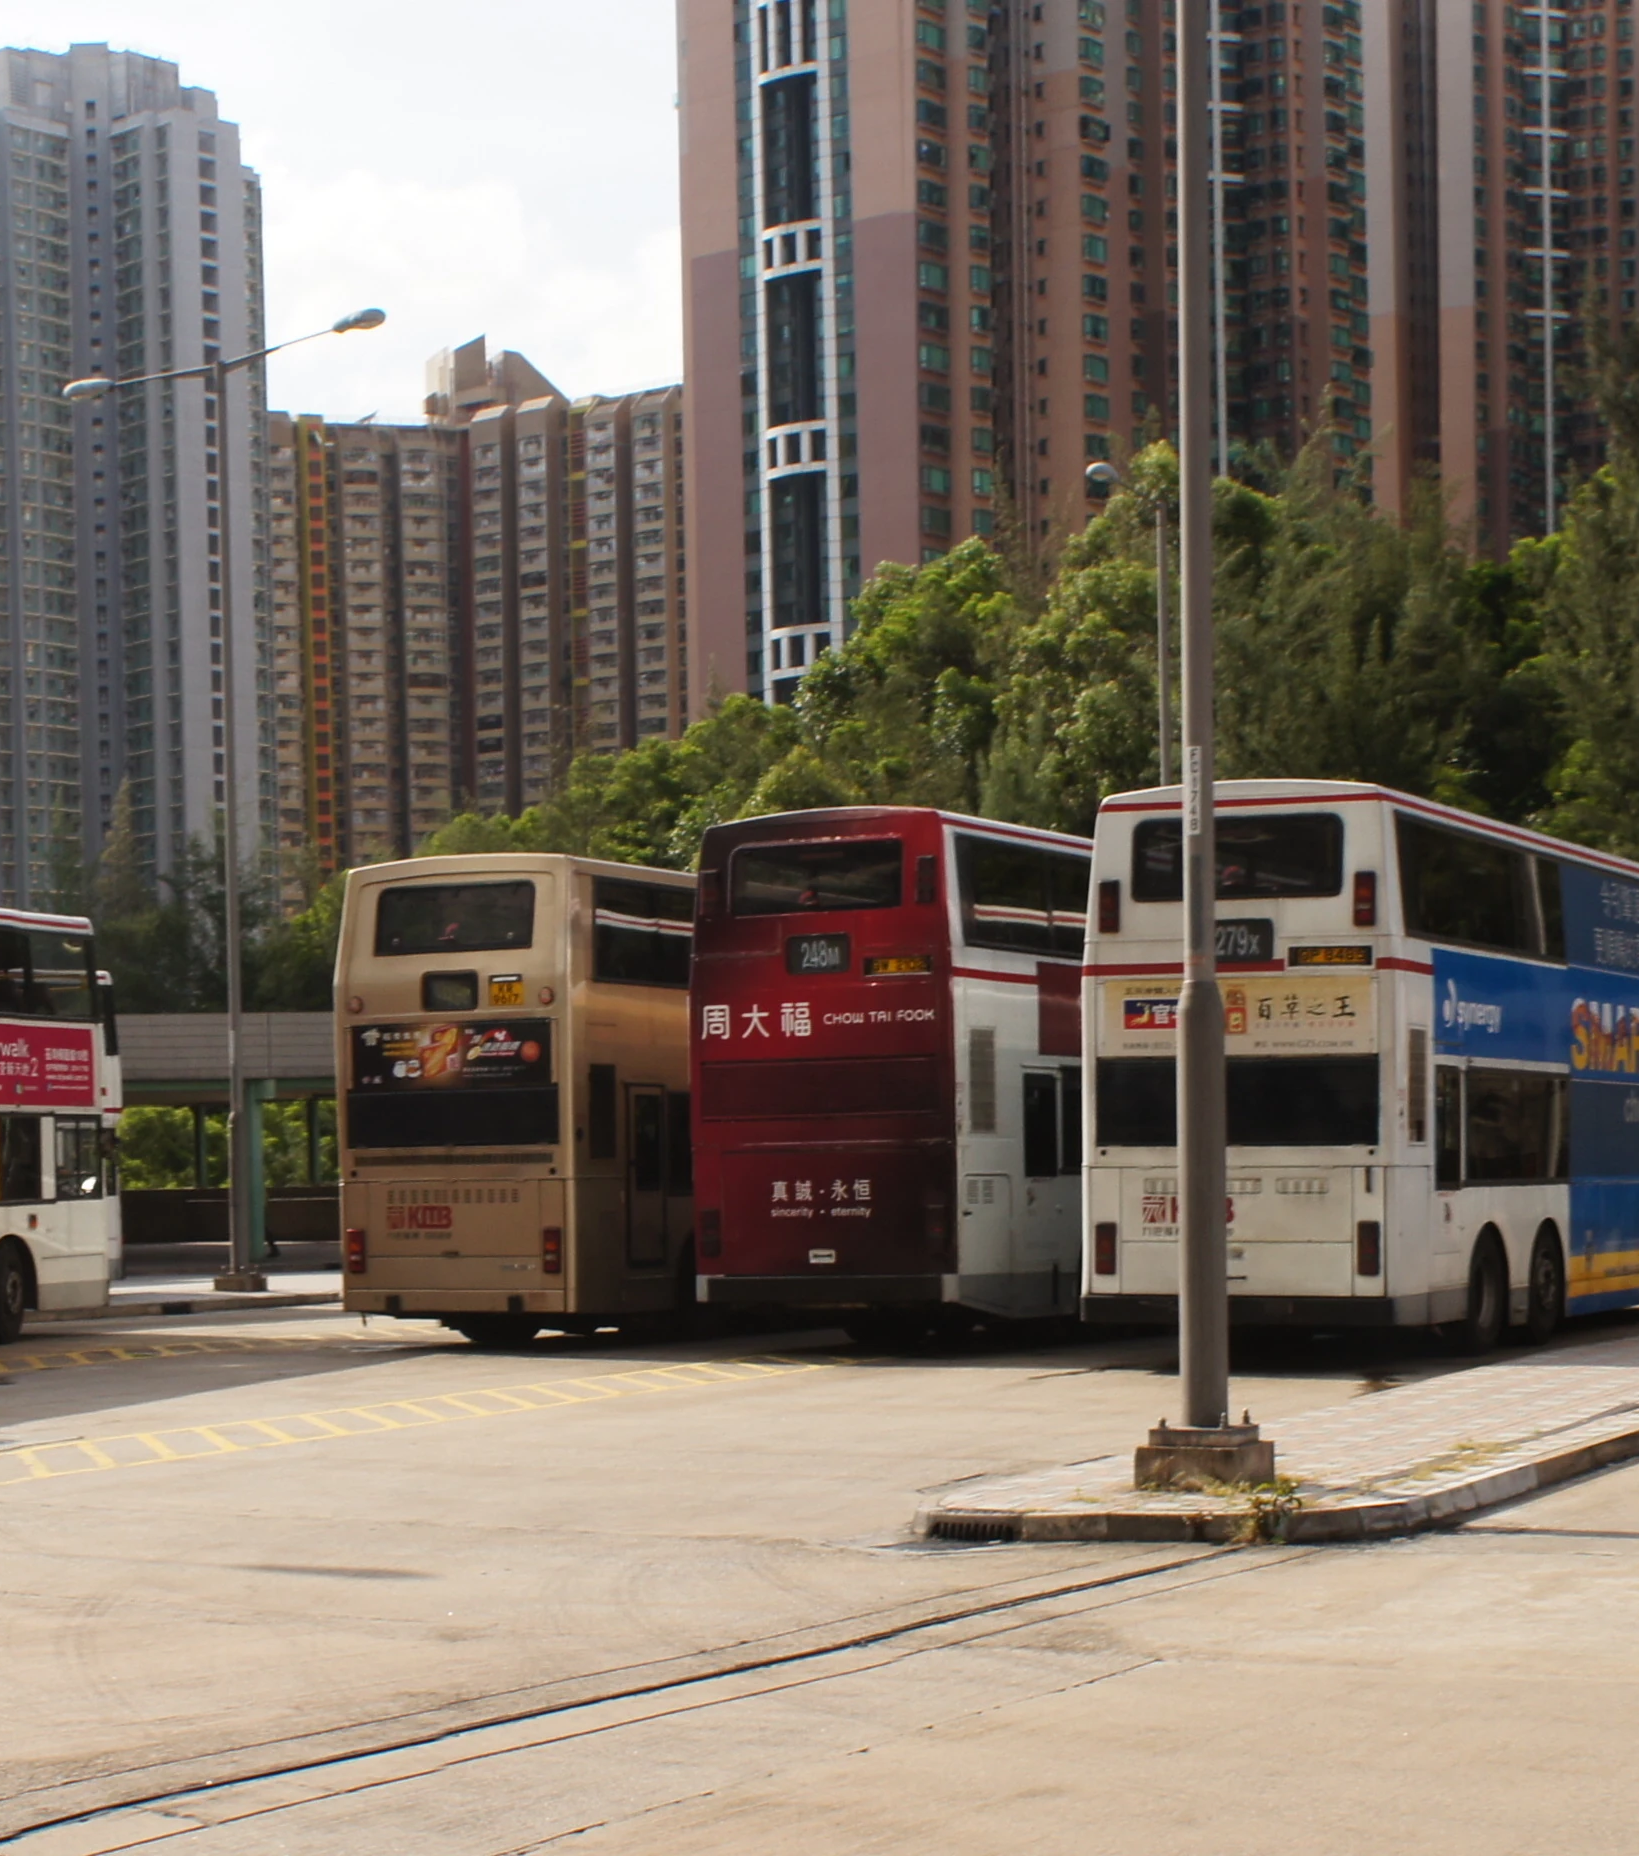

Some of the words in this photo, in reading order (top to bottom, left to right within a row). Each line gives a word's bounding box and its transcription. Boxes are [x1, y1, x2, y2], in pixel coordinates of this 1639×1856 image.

[823, 1012, 864, 1025] CHOW
[869, 1010, 891, 1023] TAI
[897, 1008, 935, 1022] FOOK
[1256, 995, 1356, 1019] 百草之王
[701, 1002, 812, 1040] 周大福
[770, 1207, 814, 1219] sincerity
[830, 1206, 871, 1219] eternity
